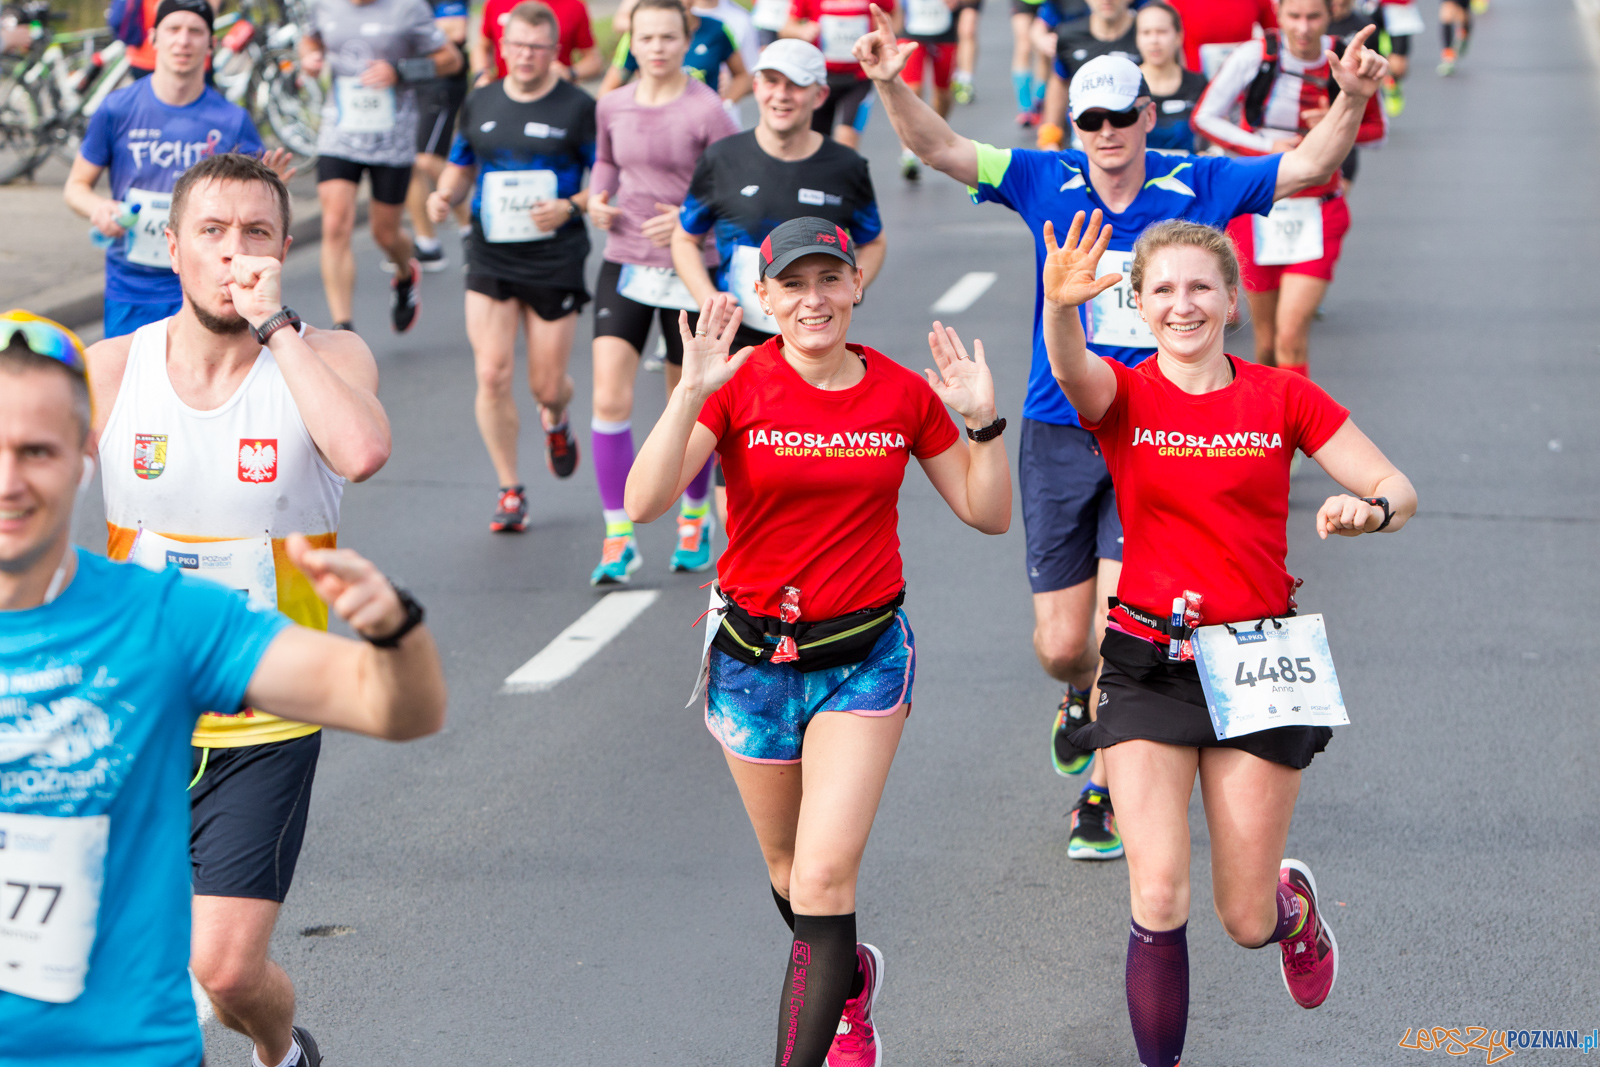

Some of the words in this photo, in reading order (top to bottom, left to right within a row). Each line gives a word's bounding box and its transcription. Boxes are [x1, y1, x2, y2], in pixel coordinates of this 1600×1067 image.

[1113, 287, 1138, 310] 18
[747, 429, 905, 449] JAROSŁAWSKA
[1132, 426, 1282, 449] JAROSŁAWSKA
[774, 447, 821, 457] GRUPA
[825, 447, 887, 458] BIEGOWA
[1158, 447, 1203, 457] GRUPA
[1206, 447, 1266, 458] BIEGOWA
[1234, 656, 1316, 687] 4485
[1272, 684, 1294, 693] Anna
[5, 881, 63, 924] 77
[792, 966, 807, 997] SKIN
[781, 997, 804, 1067] COMPRESSION
